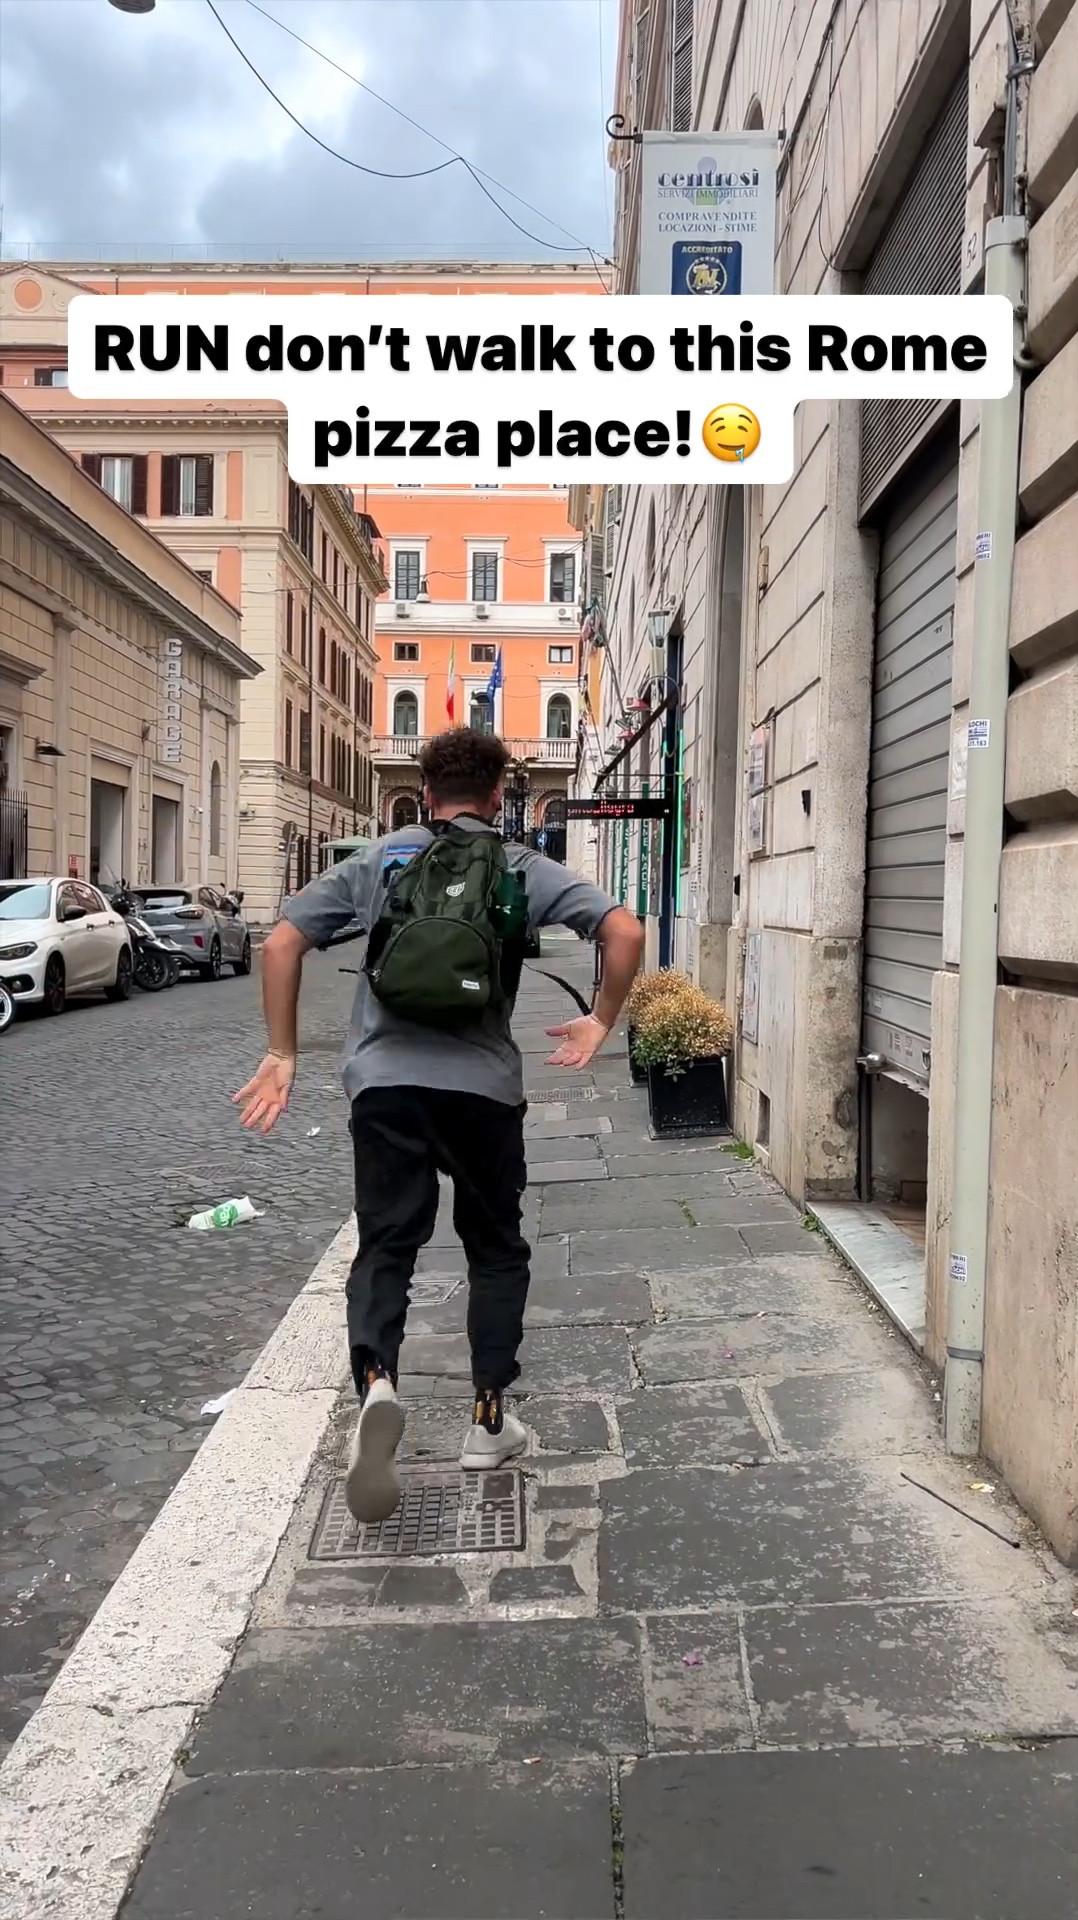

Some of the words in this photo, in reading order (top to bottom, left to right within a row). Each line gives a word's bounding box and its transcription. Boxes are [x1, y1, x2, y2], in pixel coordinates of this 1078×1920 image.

[657, 189, 693, 198] SERVIZI
[696, 189, 758, 198] IMMOBILIARI
[658, 211, 757, 221] COMPRAVENDITE
[658, 223, 717, 233] LOCAZIONI
[724, 223, 757, 232] STIME
[681, 246, 734, 254] ACCREDITATO
[163, 638, 182, 763] GARAGE
